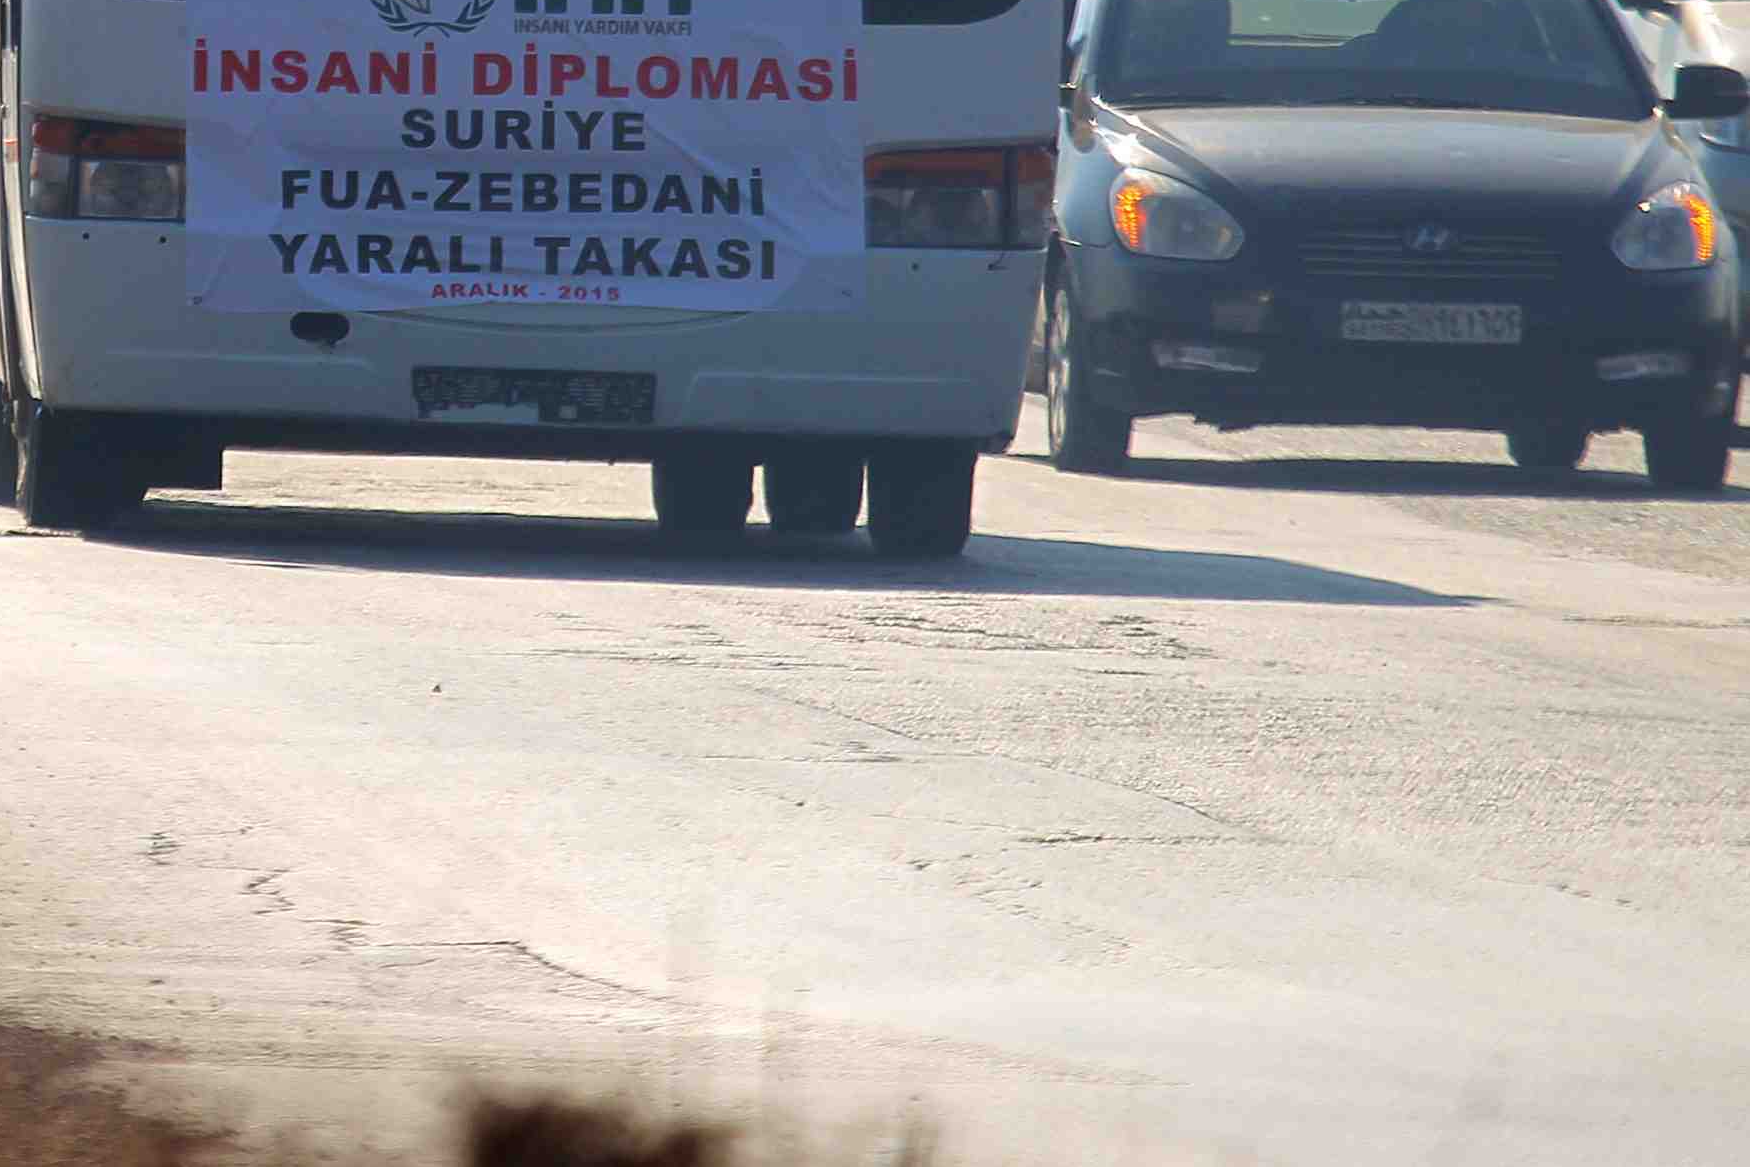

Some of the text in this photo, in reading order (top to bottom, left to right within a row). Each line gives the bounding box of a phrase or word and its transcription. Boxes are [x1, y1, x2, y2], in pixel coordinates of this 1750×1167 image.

[574, 19, 639, 35] YARDIM
[193, 38, 858, 102] İNSANİ DİPLOMASİ
[401, 100, 646, 152] SURİYE
[281, 168, 765, 216] FUA-ZEBEDANİ
[269, 234, 776, 280] YARALI TAKASI
[431, 283, 529, 299] ARALIK
[558, 285, 621, 301] 2015
